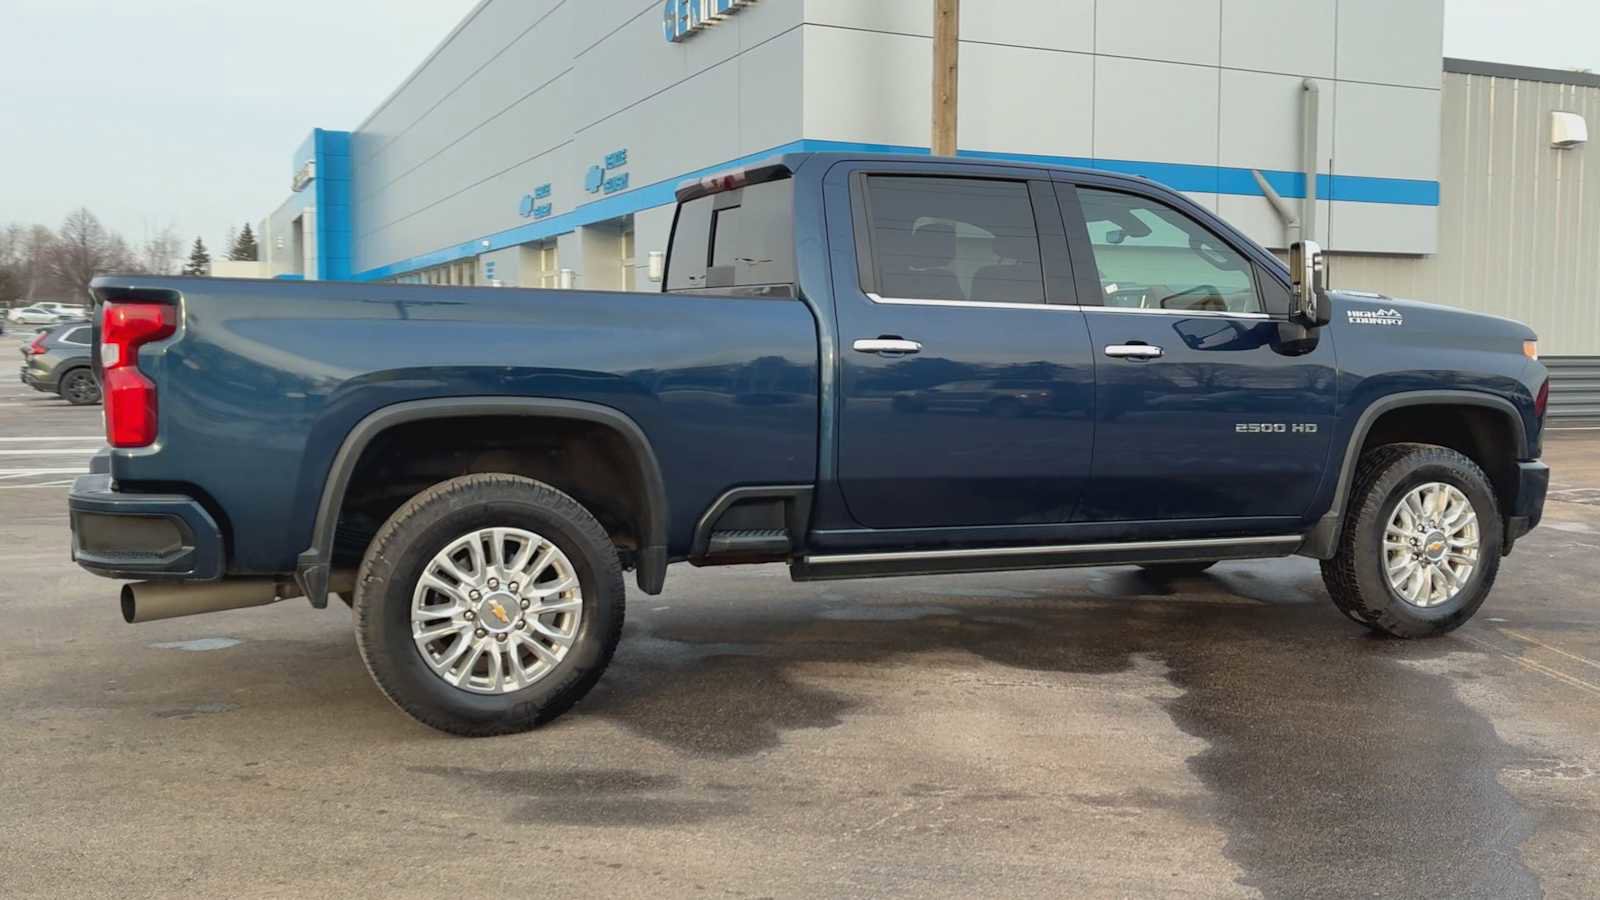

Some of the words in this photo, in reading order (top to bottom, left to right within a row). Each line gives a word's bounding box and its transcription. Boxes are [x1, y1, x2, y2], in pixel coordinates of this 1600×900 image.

[1347, 310, 1377, 318] HIGH
[1349, 317, 1403, 325] COUNTRY
[1235, 423, 1286, 433] 2500
[1291, 423, 1318, 433] HD
